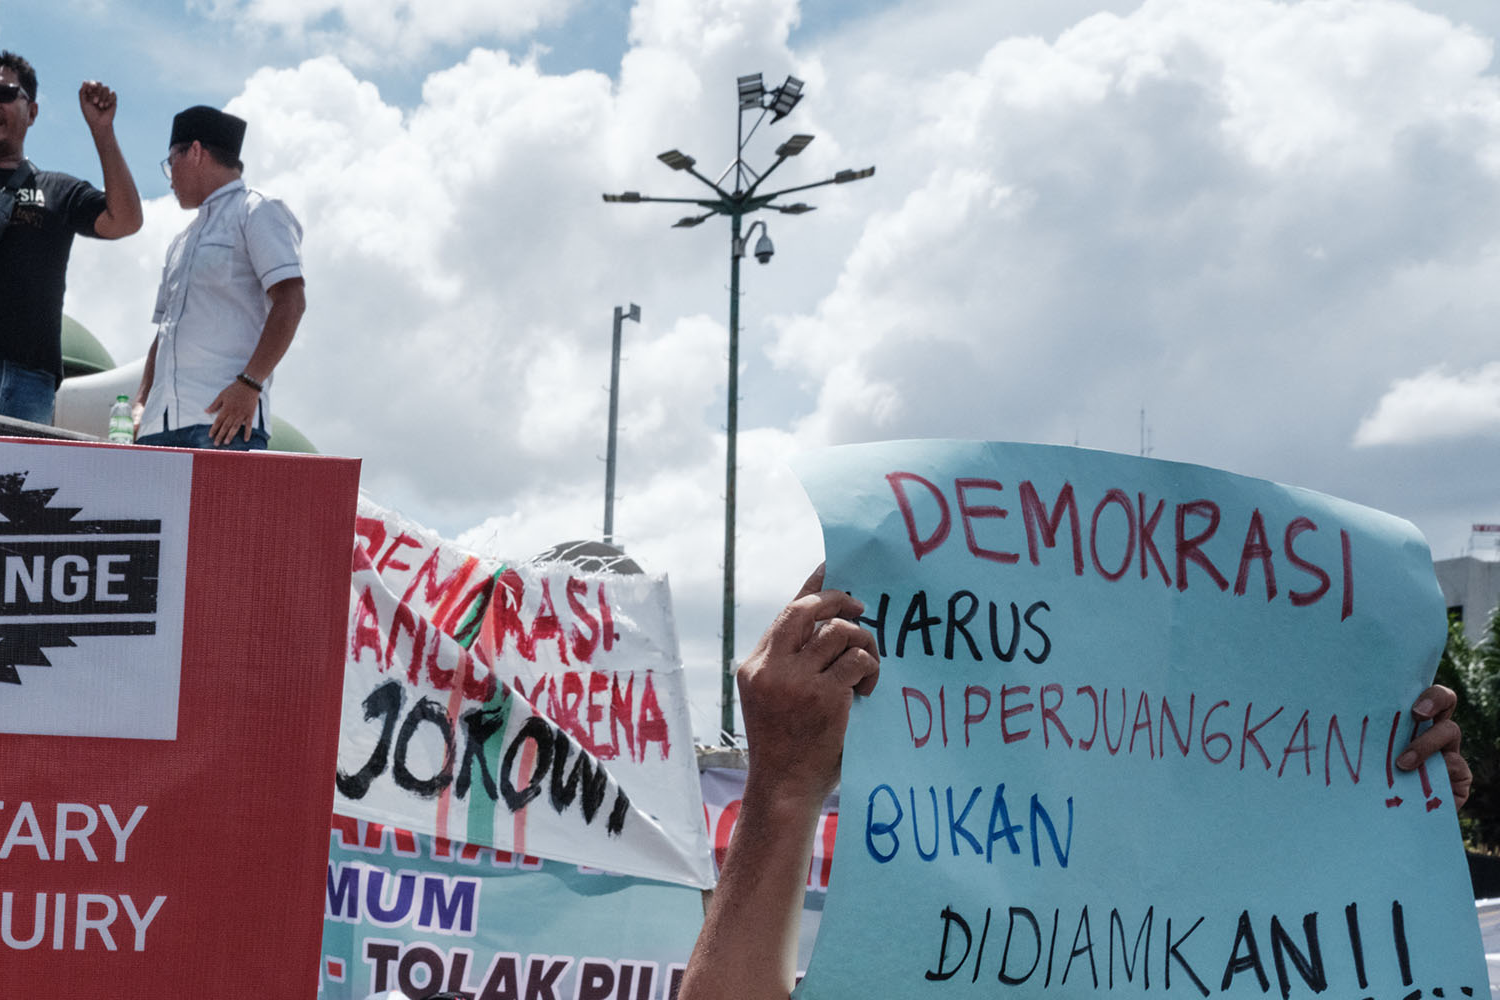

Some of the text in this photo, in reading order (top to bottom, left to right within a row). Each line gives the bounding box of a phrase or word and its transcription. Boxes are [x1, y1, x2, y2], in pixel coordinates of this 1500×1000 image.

[886, 471, 1353, 622] DEMOKRASI
[845, 589, 1052, 664] HARUS
[865, 784, 1074, 867] BUKAN
[325, 864, 477, 932] MUM
